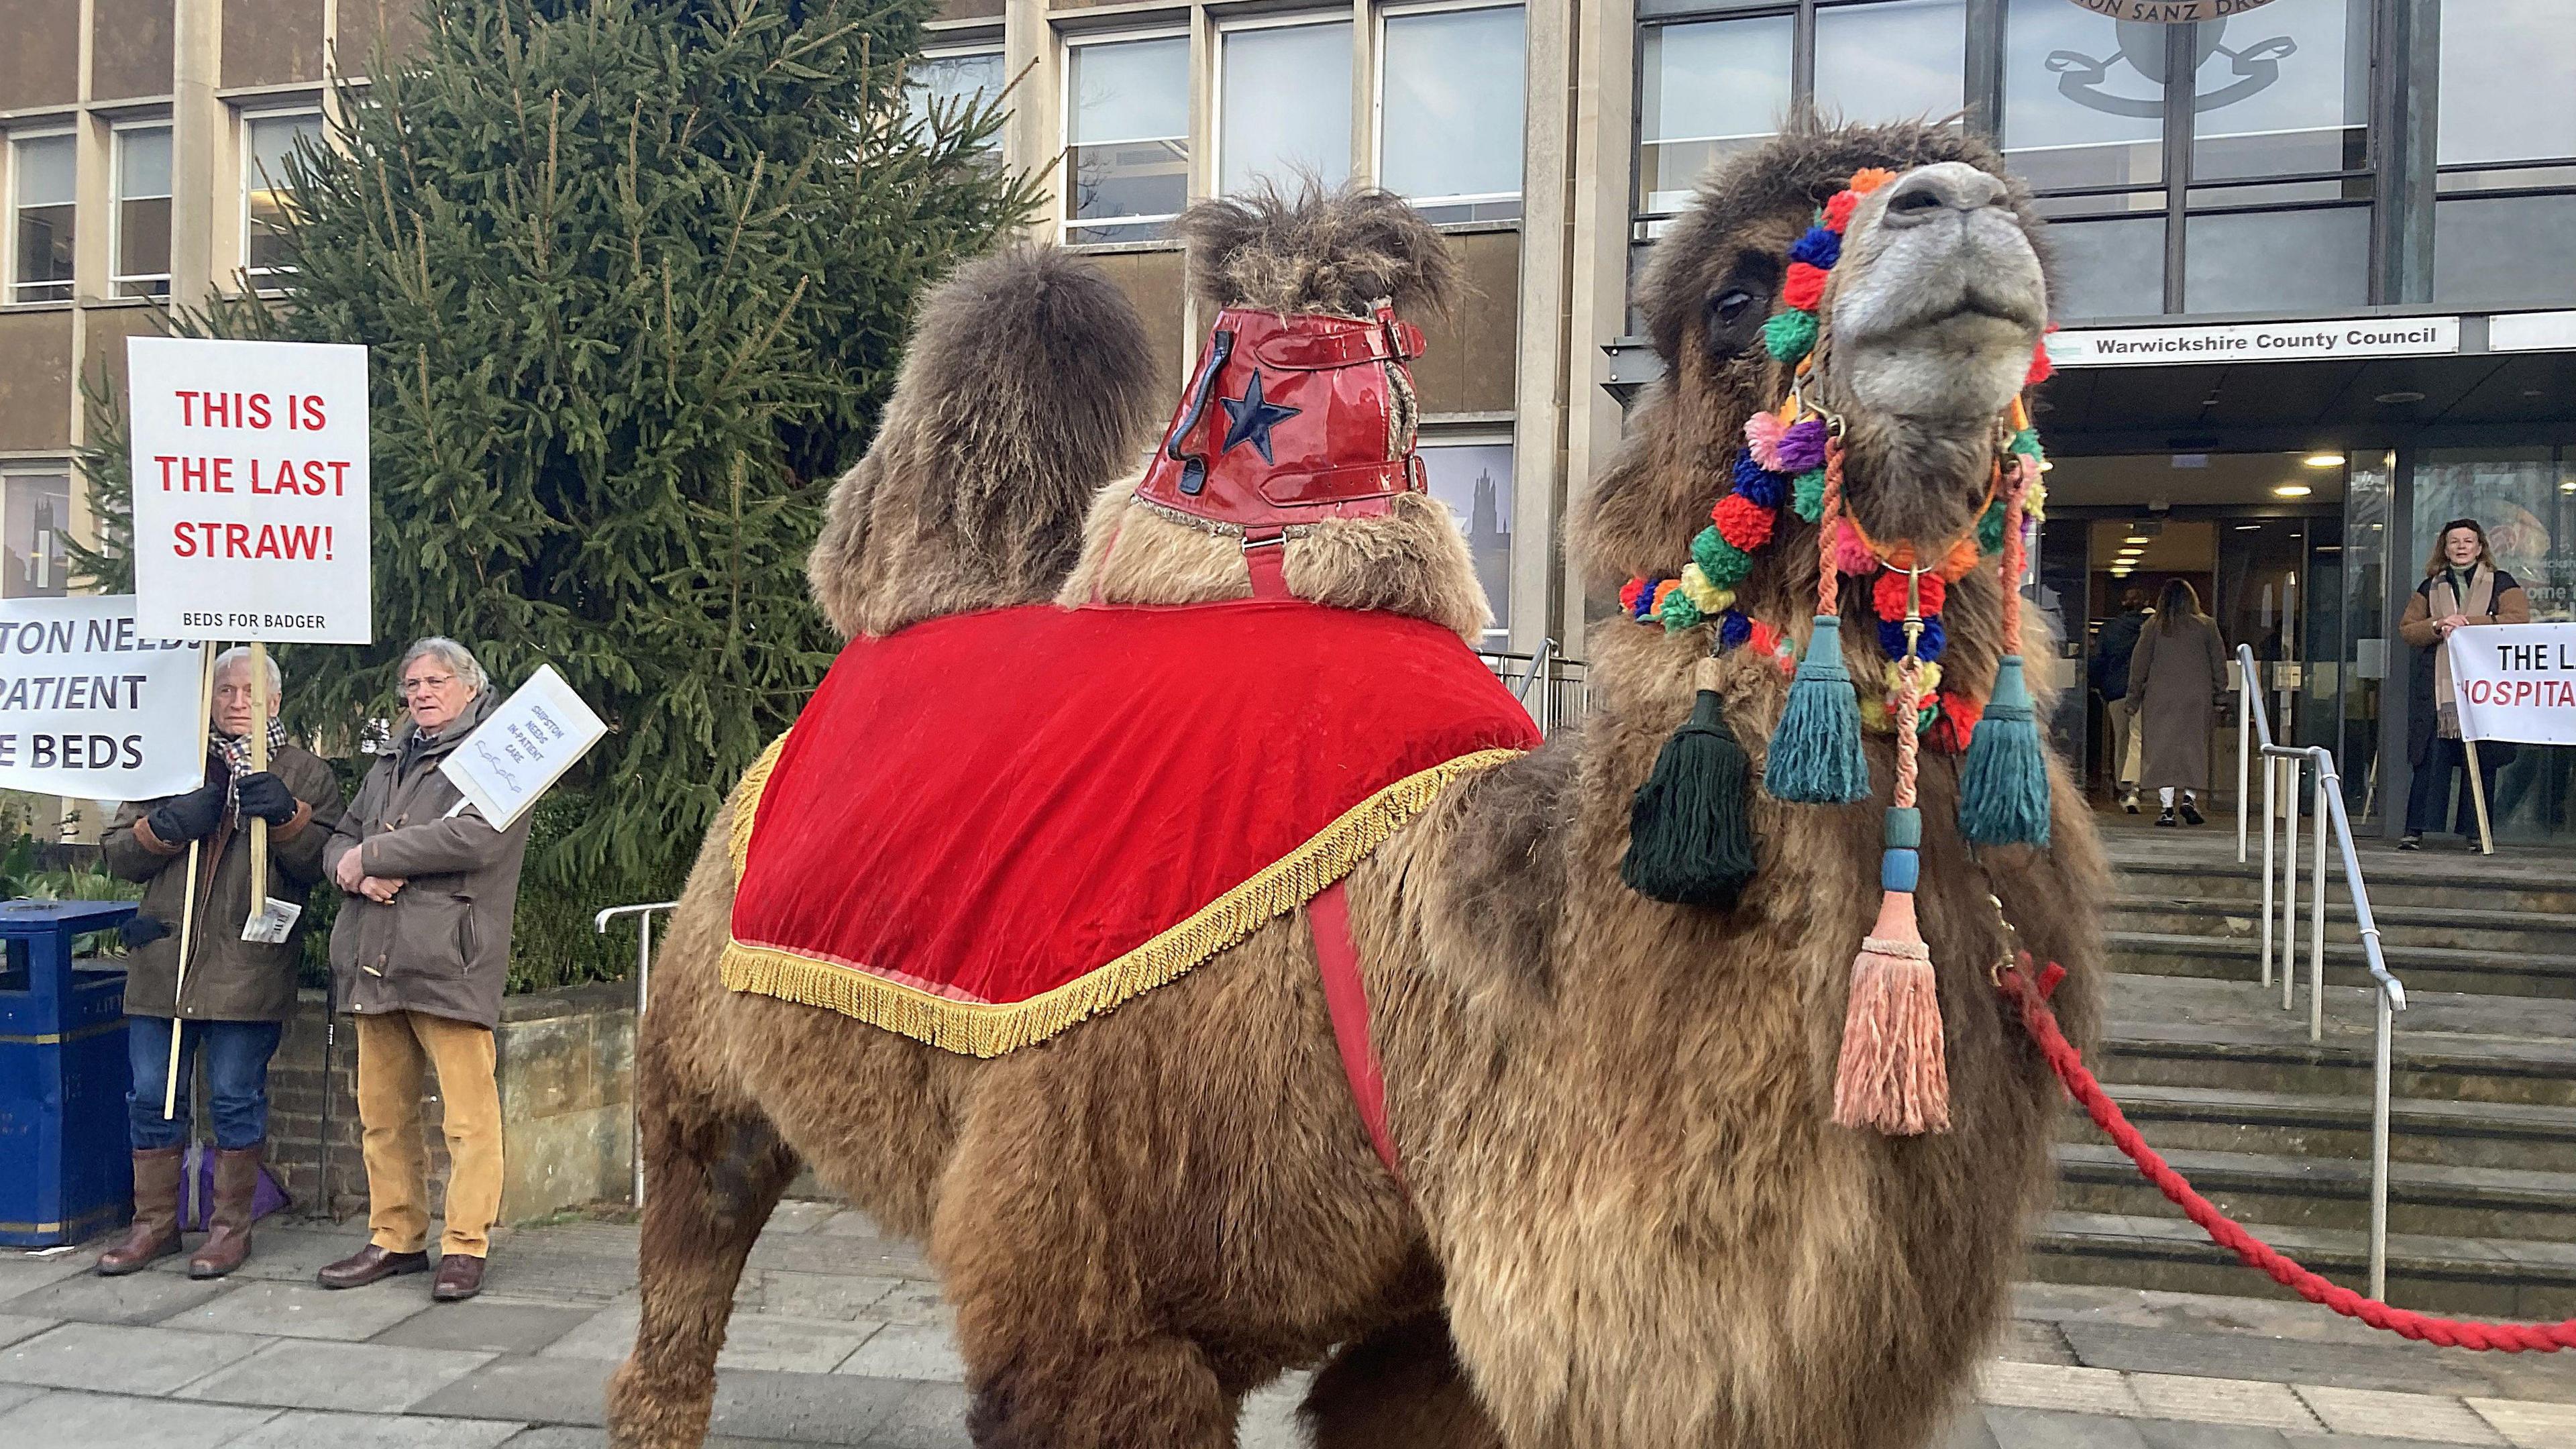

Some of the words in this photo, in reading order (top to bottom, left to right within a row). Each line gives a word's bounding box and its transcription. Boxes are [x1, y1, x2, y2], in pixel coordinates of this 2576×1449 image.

[2080, 0, 2123, 14] ON
[2132, 4, 2202, 21] SANZ
[2216, 0, 2266, 15] DR
[2096, 335, 2248, 354] Warwickshire
[2257, 332, 2339, 350] County
[2347, 328, 2437, 345] Council
[175, 391, 272, 429] THIS
[289, 394, 326, 431] IS
[154, 456, 234, 493] THE
[251, 459, 351, 496] LAST
[173, 521, 333, 561] STRAW!
[183, 612, 223, 627] BEDS
[229, 614, 259, 628] FOR
[264, 614, 326, 629] BADGER
[2498, 645, 2548, 671] THE
[2560, 644, 2576, 670] L
[525, 720, 548, 745] NEEDS
[531, 705, 564, 739] SHIPSTON
[30, 734, 143, 769] BEDS
[505, 744, 525, 764] CARE
[507, 723, 544, 762] IN-PATIENT
